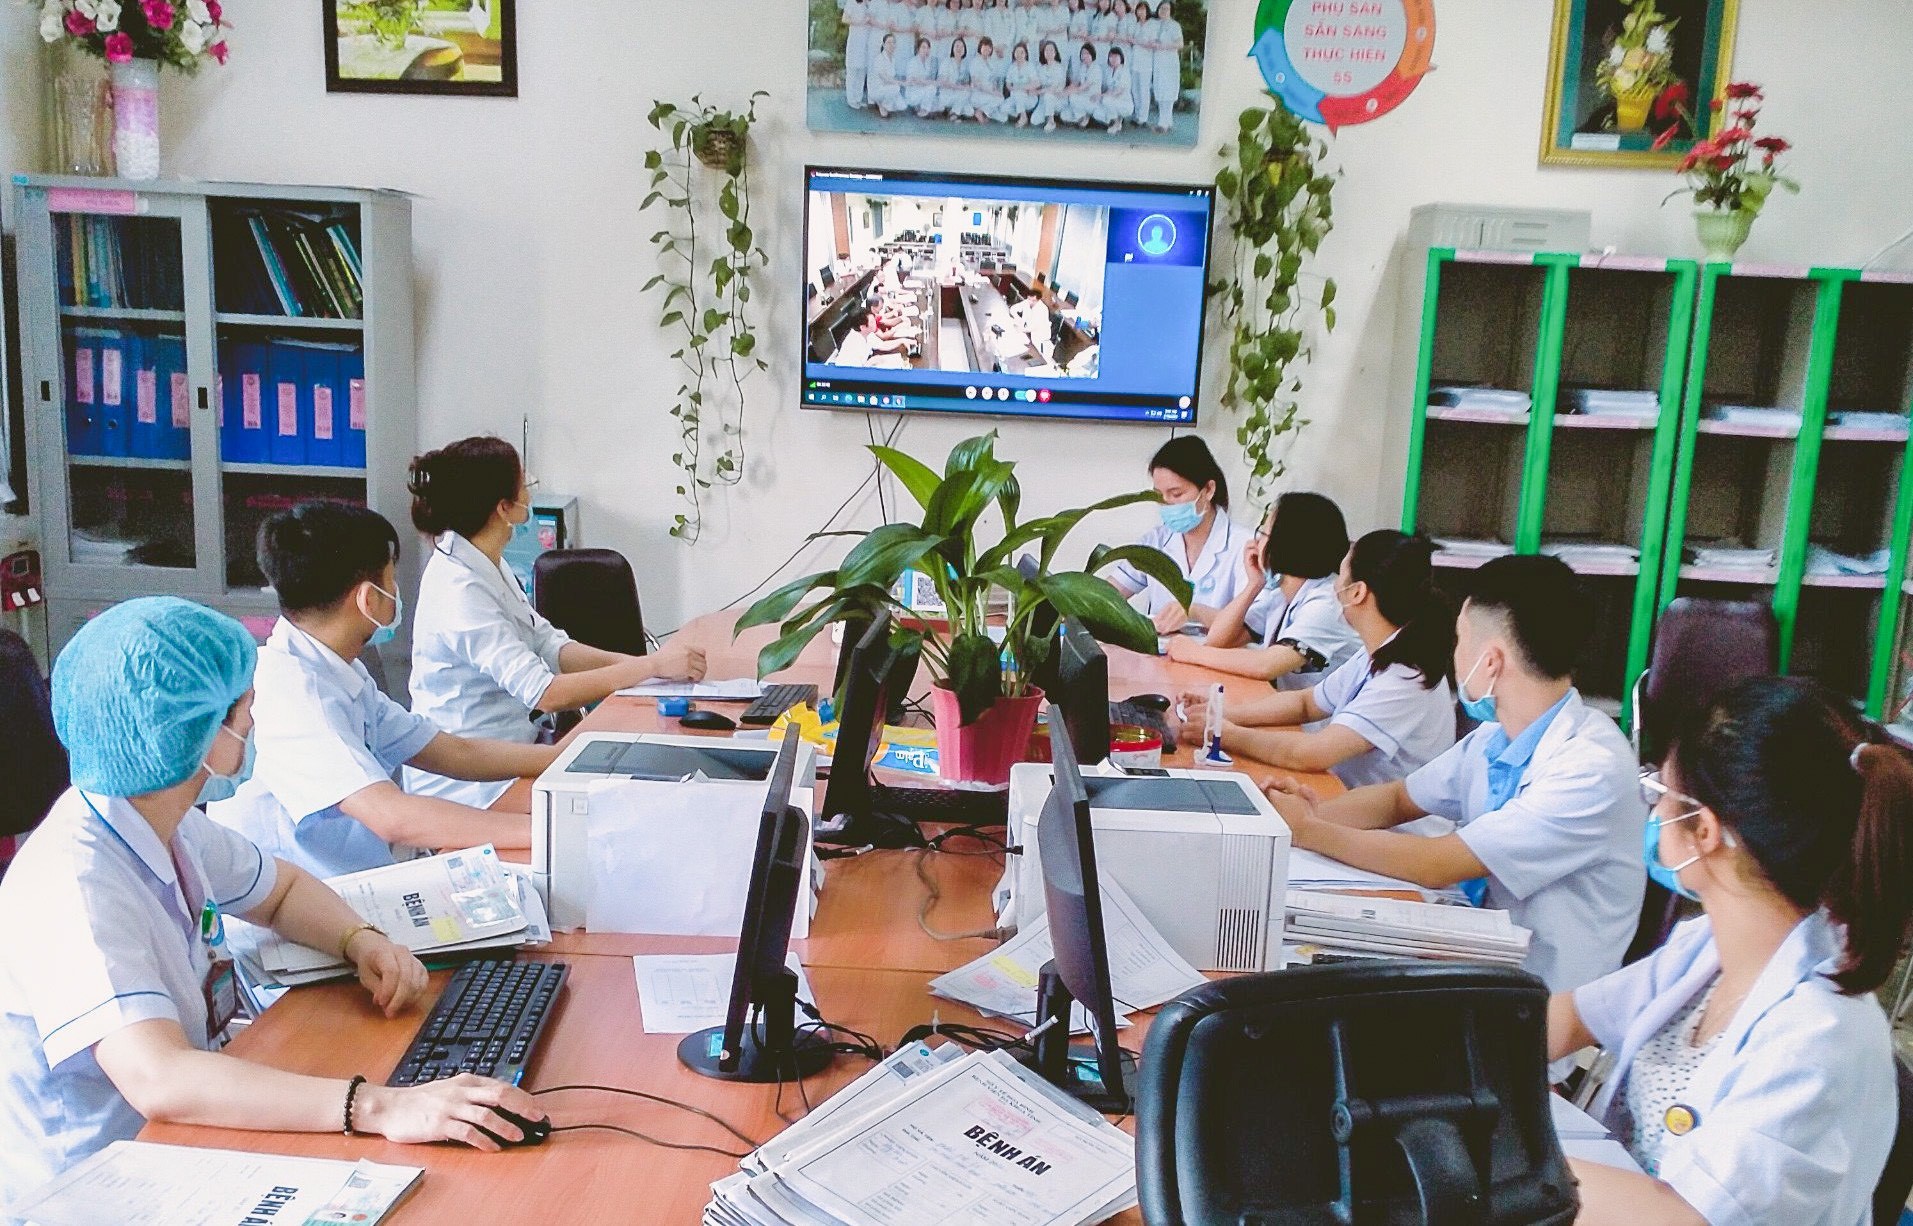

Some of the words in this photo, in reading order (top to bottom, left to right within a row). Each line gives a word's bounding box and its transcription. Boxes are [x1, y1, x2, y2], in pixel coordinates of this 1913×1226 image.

[963, 1125, 1022, 1160] BỆNH
[1016, 1155, 1052, 1175] ÁN
[250, 1186, 299, 1216] BỆNH
